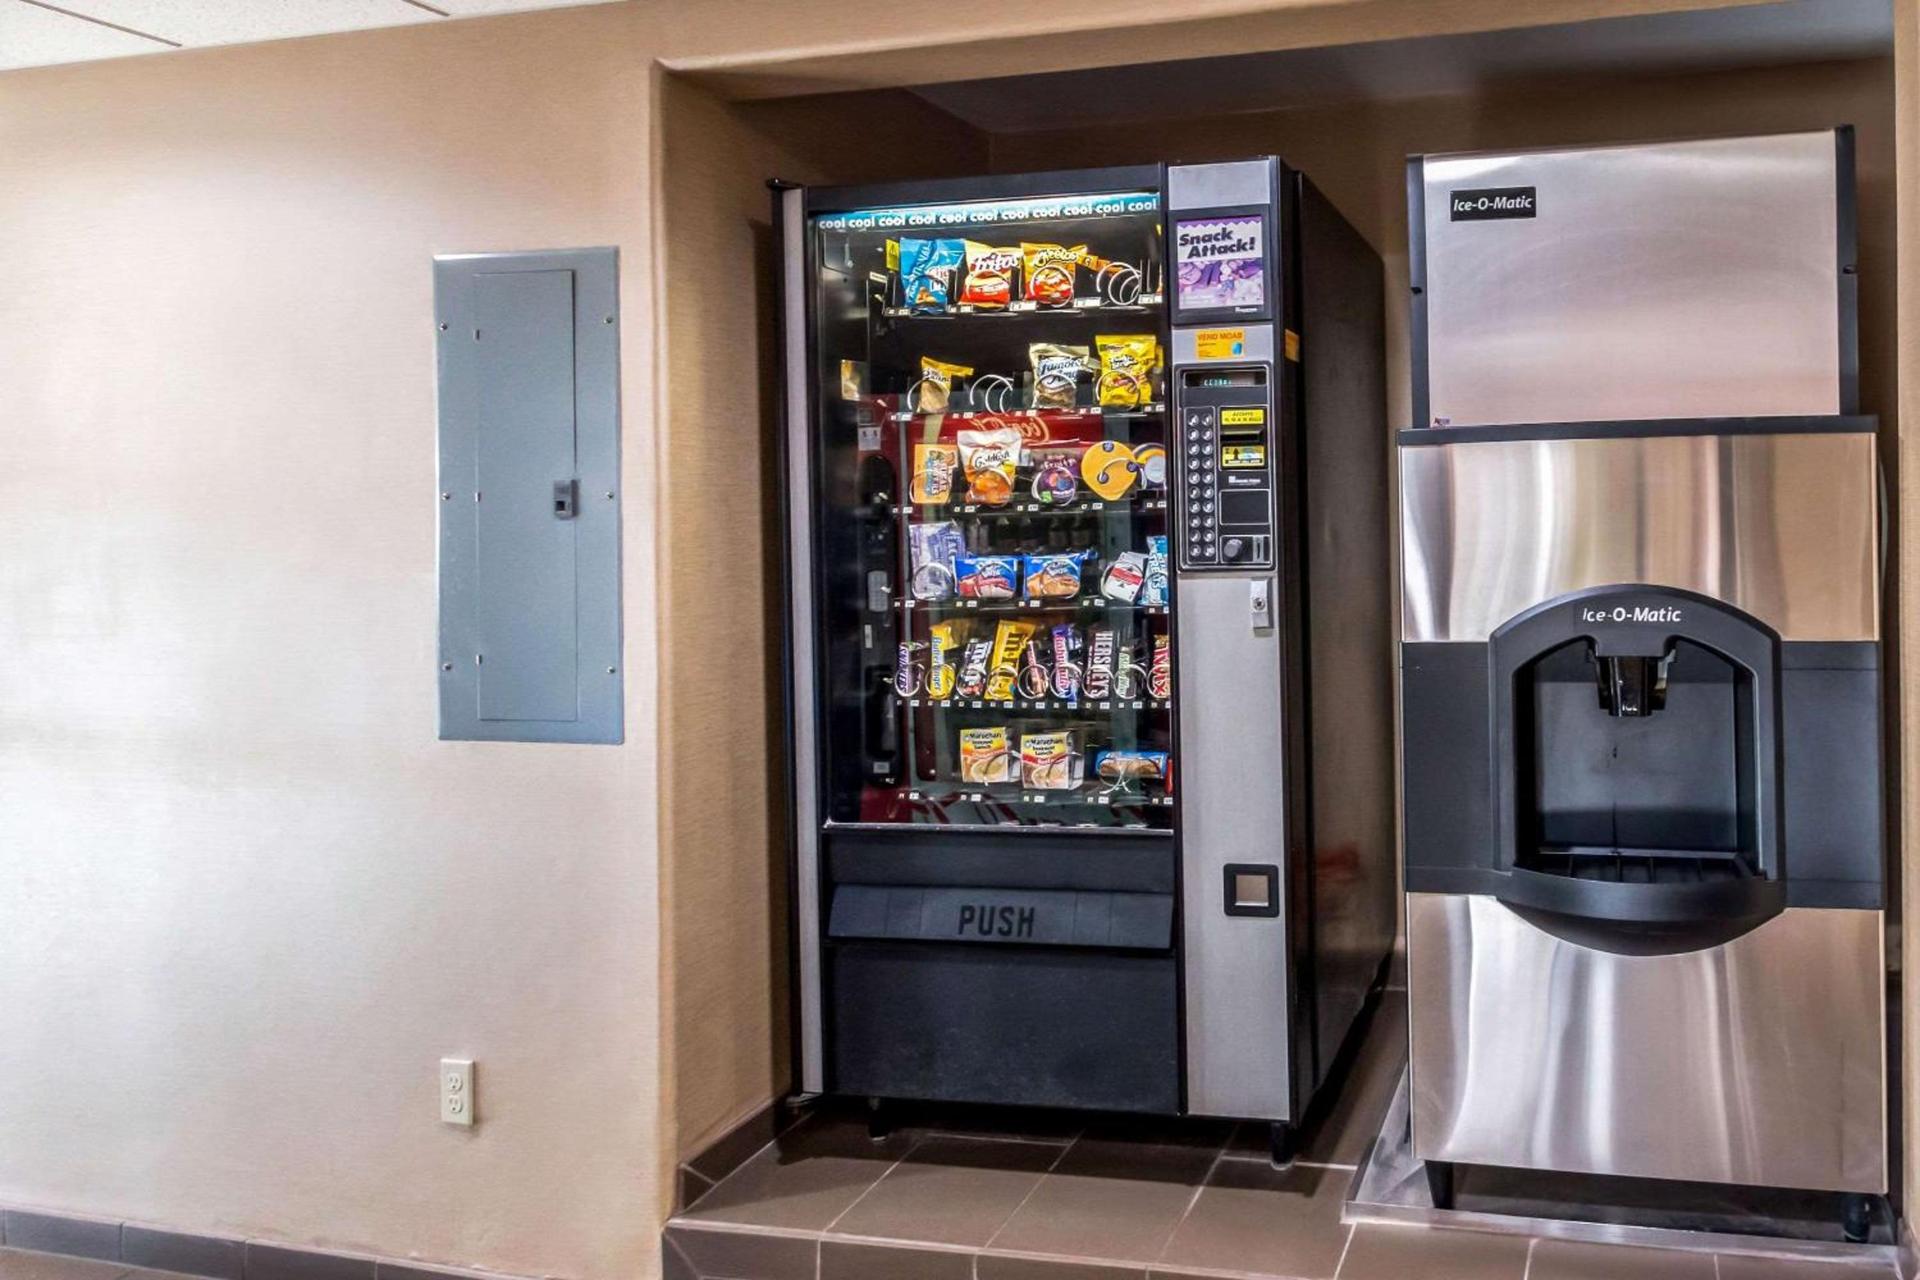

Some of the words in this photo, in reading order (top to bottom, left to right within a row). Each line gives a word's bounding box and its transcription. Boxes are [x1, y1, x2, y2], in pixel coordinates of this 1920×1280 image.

[819, 217, 845, 229] cool
[848, 216, 875, 228] cool
[878, 215, 906, 227] cool
[909, 214, 936, 225] cool
[970, 209, 998, 222] cool
[1001, 208, 1029, 220] cool
[1032, 206, 1060, 218] cool
[1064, 204, 1093, 216] cool
[1096, 201, 1125, 214] cool
[1128, 198, 1157, 212] cool
[1453, 195, 1533, 212] Ice-O-Matic
[1179, 227, 1234, 246] Snack
[1187, 237, 1256, 259] Attack!
[1582, 607, 1682, 622] Ice-O-Matic
[1091, 631, 1113, 697] HERSHEY'S
[1152, 646, 1169, 696] TWIX
[958, 904, 1035, 938] PUSH
